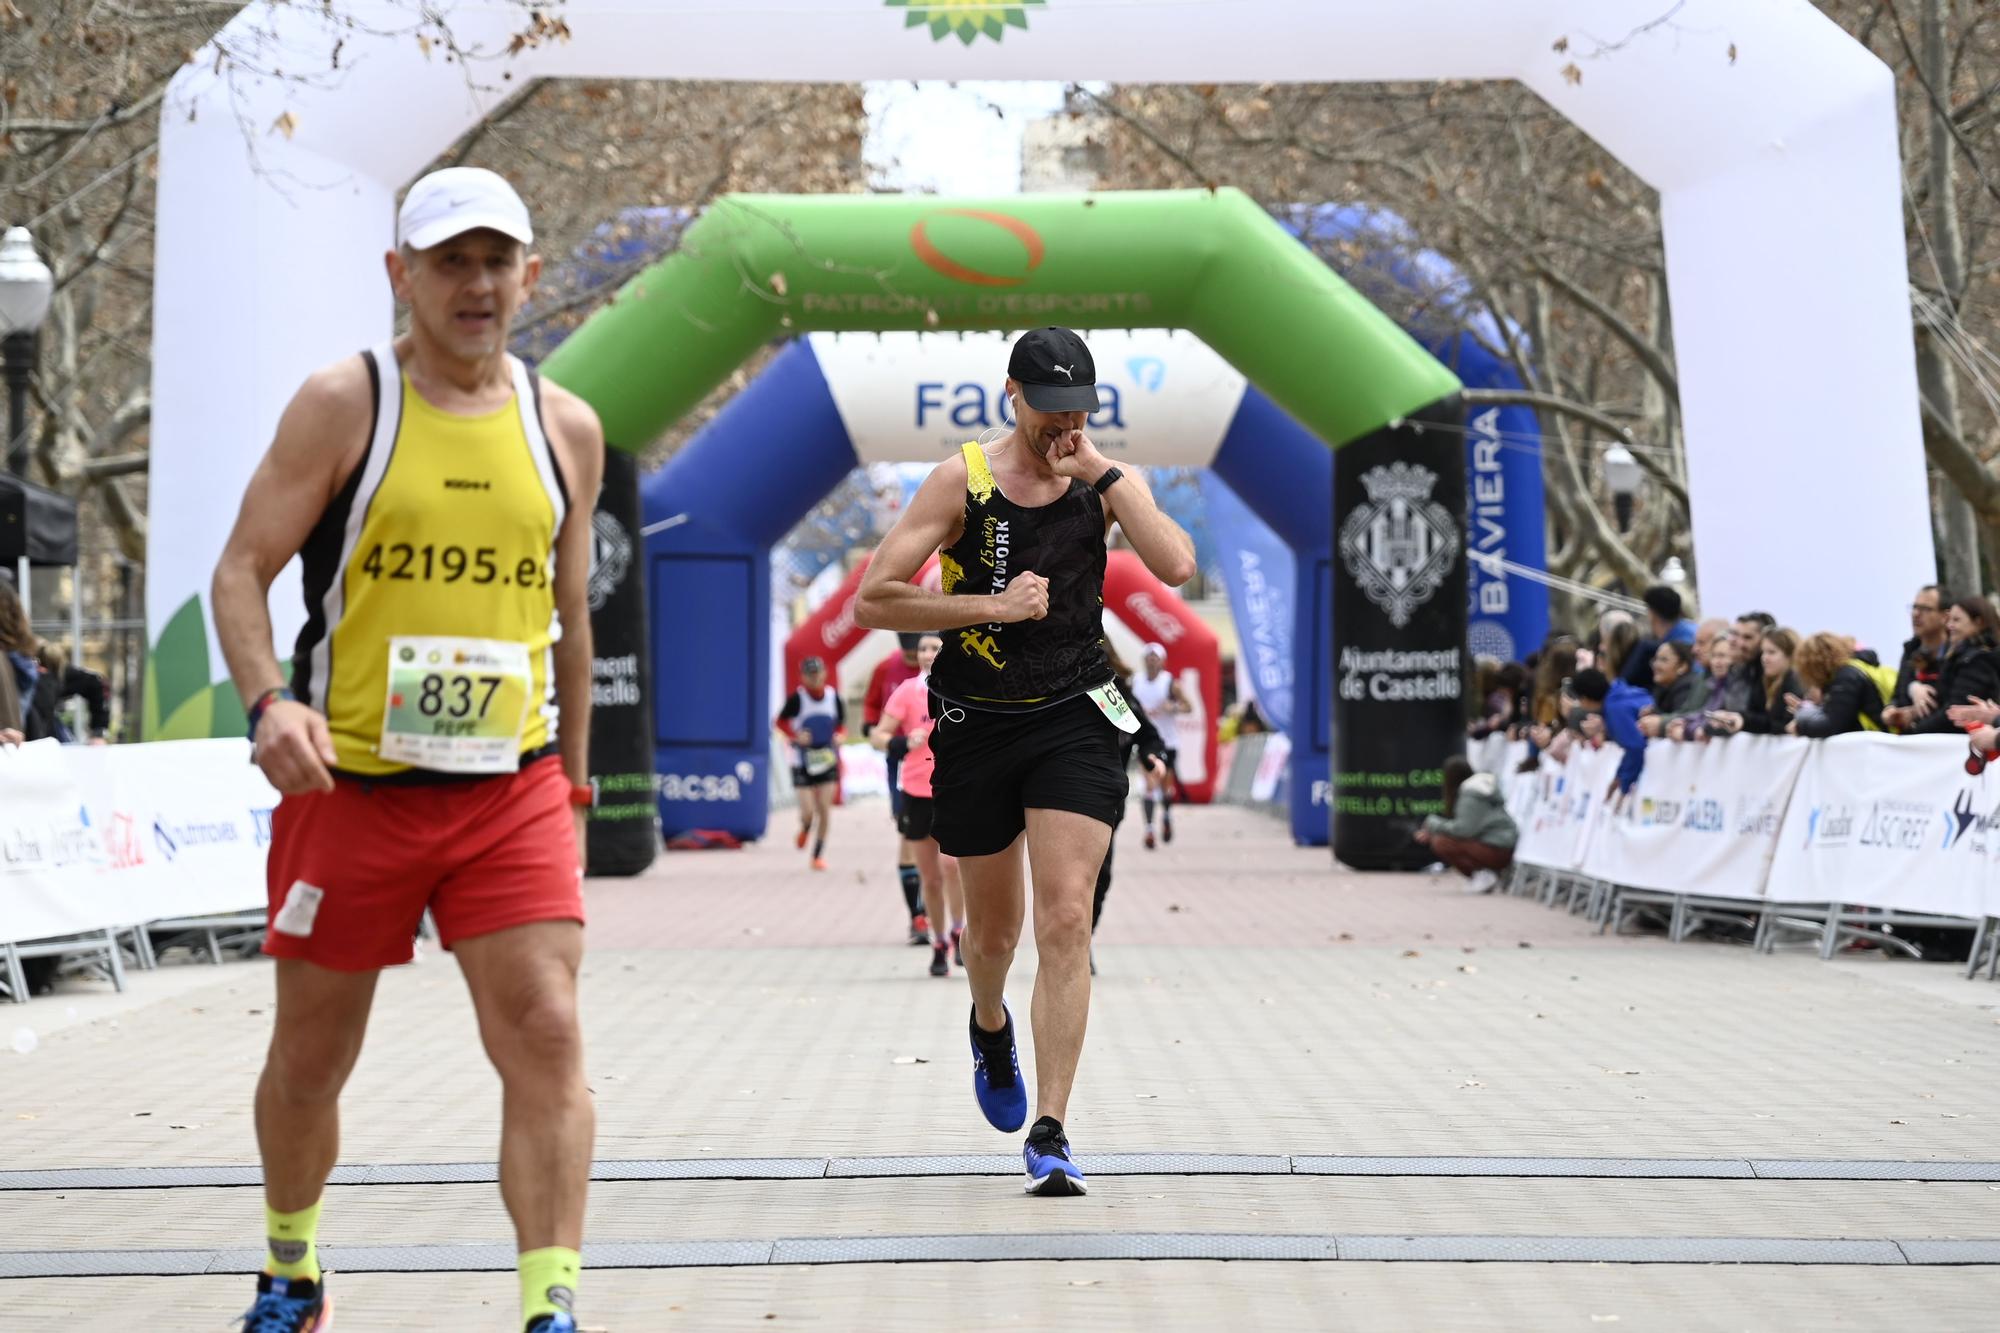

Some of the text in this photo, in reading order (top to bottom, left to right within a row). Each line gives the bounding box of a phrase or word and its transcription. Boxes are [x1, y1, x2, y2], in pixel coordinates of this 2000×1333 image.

[803, 291, 1153, 314] PATRONAT D'ESPORTS
[1473, 406, 1509, 615] BAVIERA
[1339, 647, 1460, 677] Ajuntament
[418, 673, 503, 719] 837
[1339, 672, 1461, 701] de Castelló
[432, 718, 478, 737] PEPE
